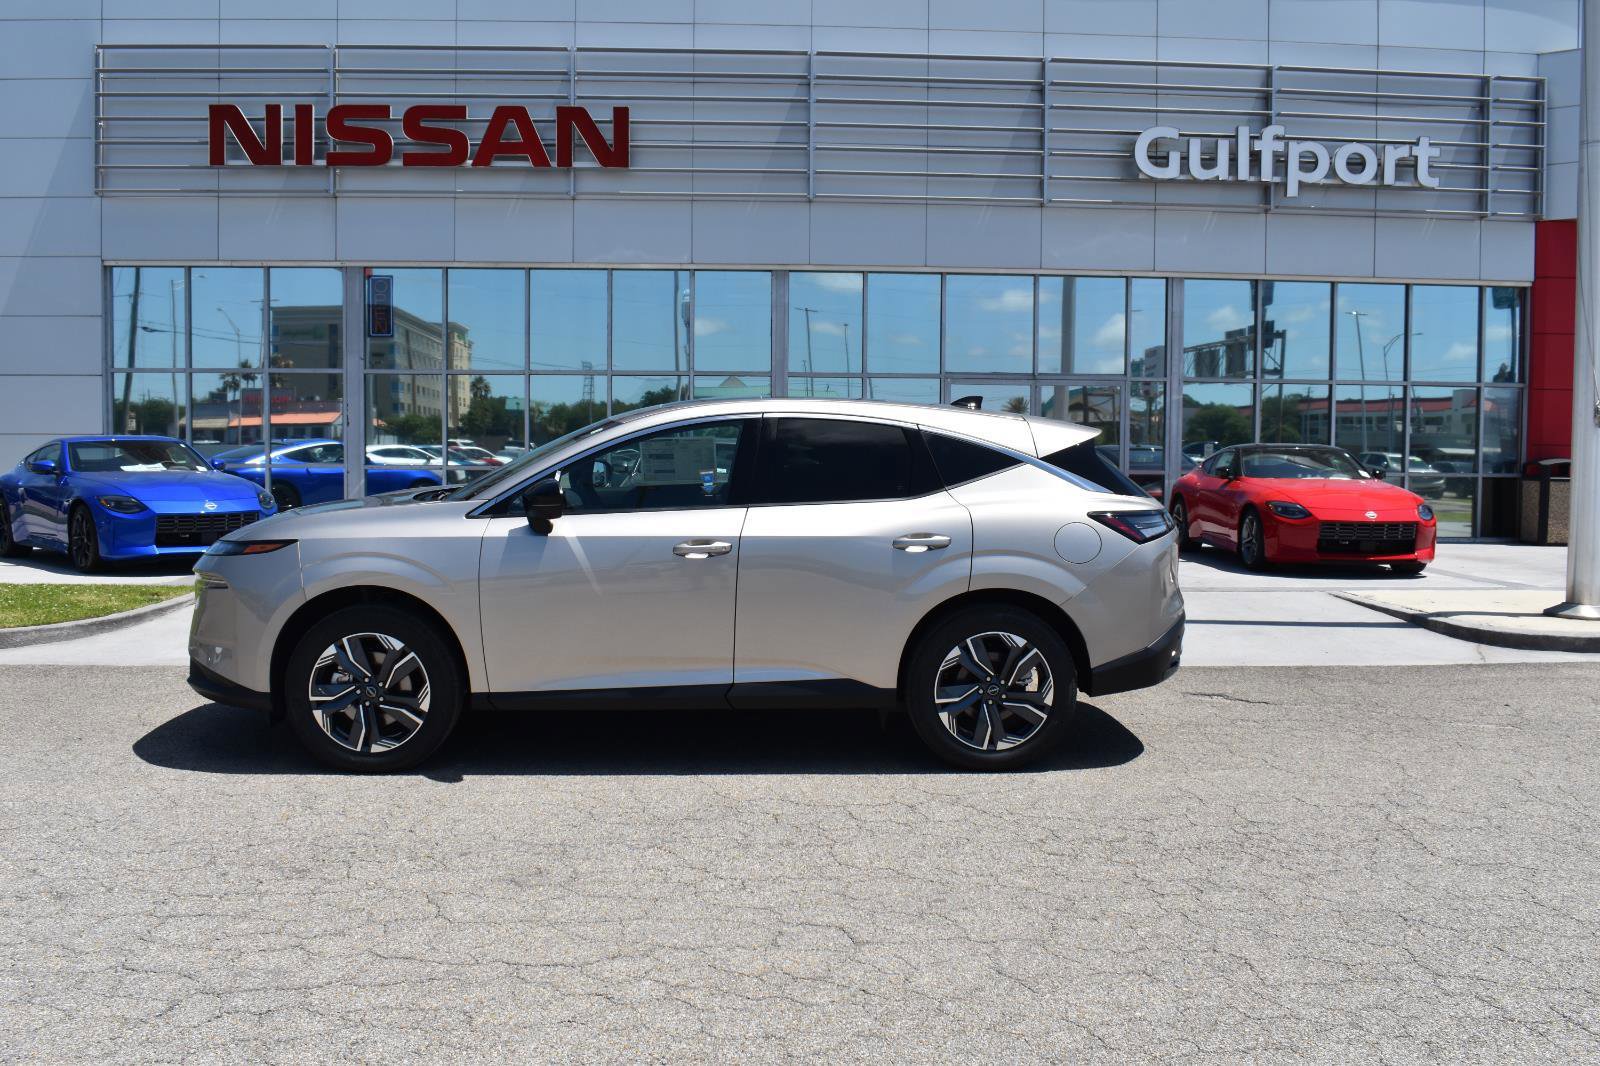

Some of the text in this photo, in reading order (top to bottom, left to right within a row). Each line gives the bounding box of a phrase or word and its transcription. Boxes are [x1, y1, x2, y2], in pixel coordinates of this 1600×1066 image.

[208, 104, 630, 168] NISSAN
[1134, 125, 1441, 197] Gulfport
[374, 279, 389, 333] OPEN
